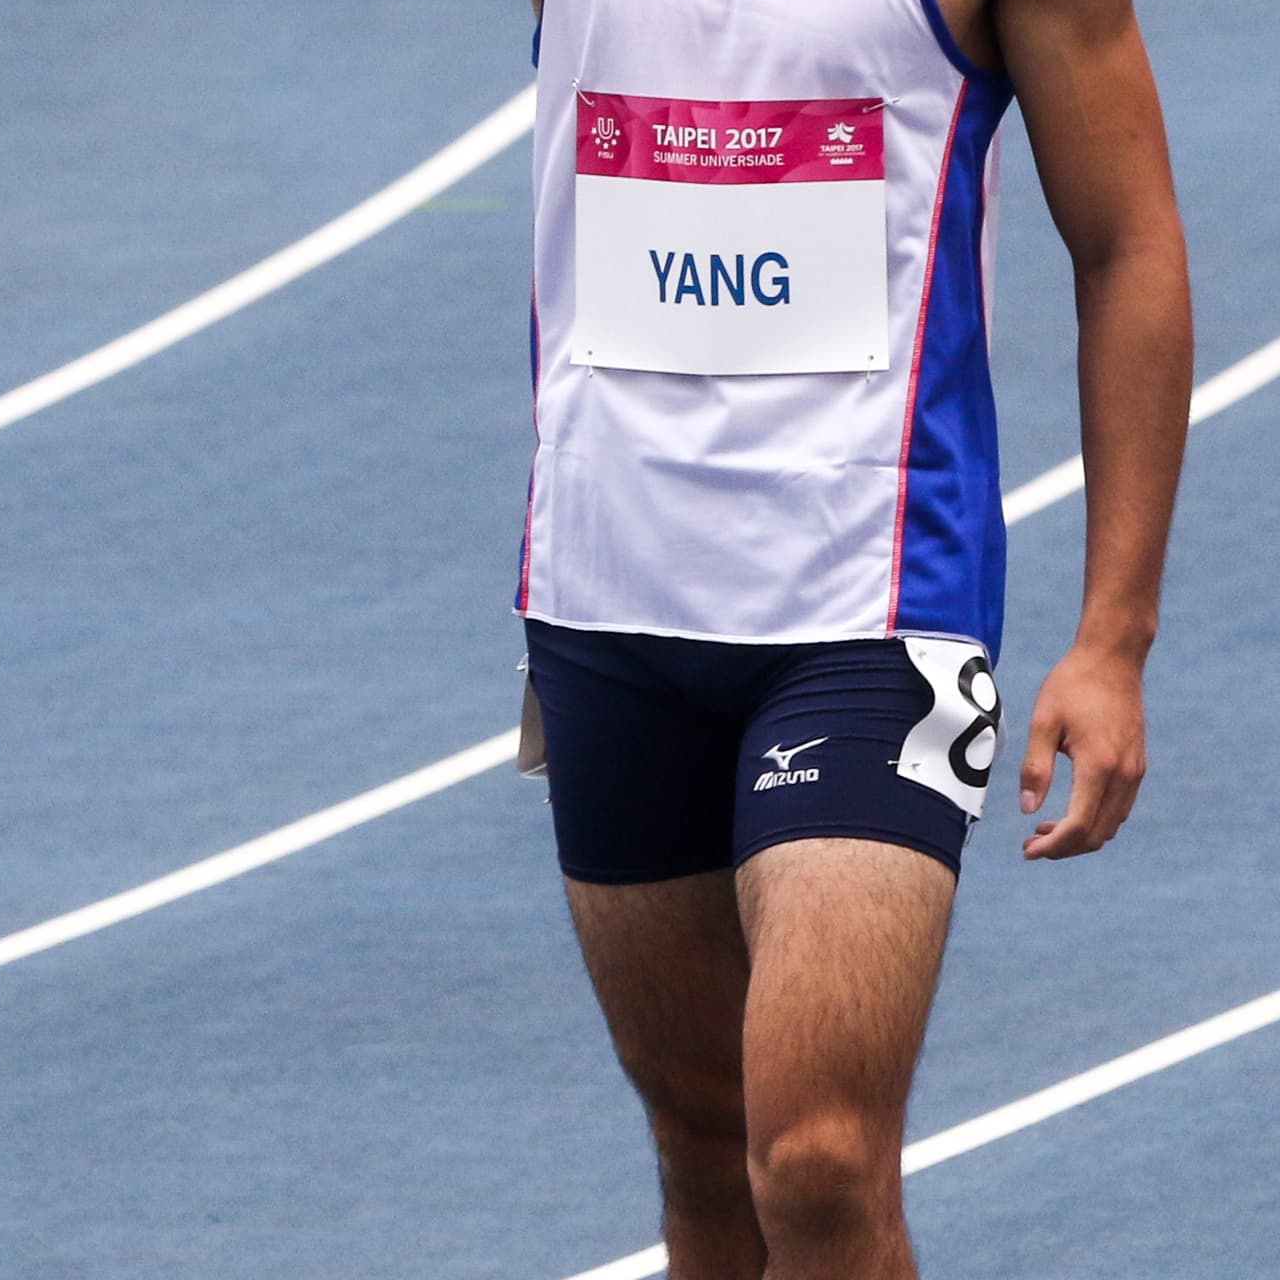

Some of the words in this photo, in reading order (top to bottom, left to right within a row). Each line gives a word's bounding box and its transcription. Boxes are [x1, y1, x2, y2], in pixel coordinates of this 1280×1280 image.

[652, 124, 717, 149] TAIPEI
[725, 127, 784, 150] 2017
[653, 150, 698, 166] SUMMER
[700, 153, 785, 167] UNIVERSIADE
[649, 250, 790, 307] YANG
[948, 656, 1003, 788] 8
